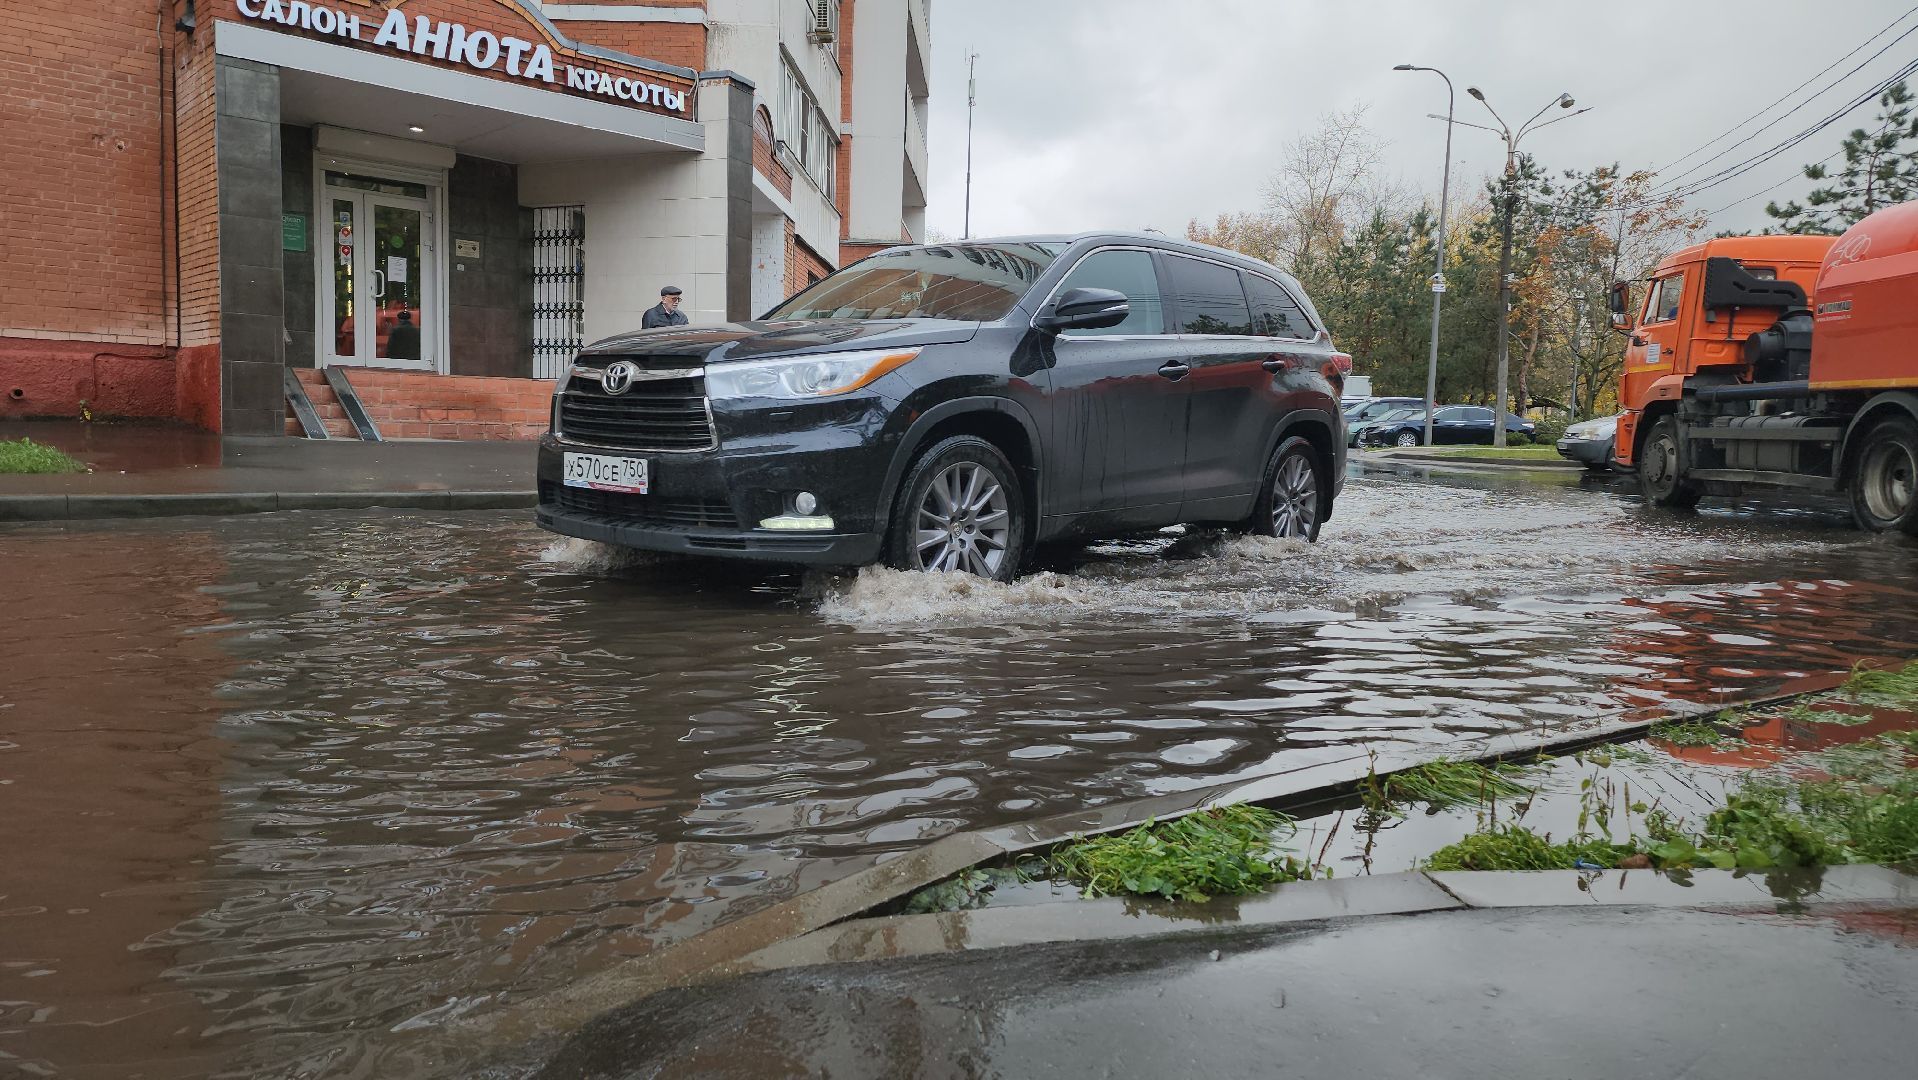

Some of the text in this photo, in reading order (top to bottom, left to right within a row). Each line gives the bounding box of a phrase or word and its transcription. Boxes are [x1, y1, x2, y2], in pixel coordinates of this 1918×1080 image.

[236, 0, 686, 112] САЛОН АНЮТА КРАСОТЫ
